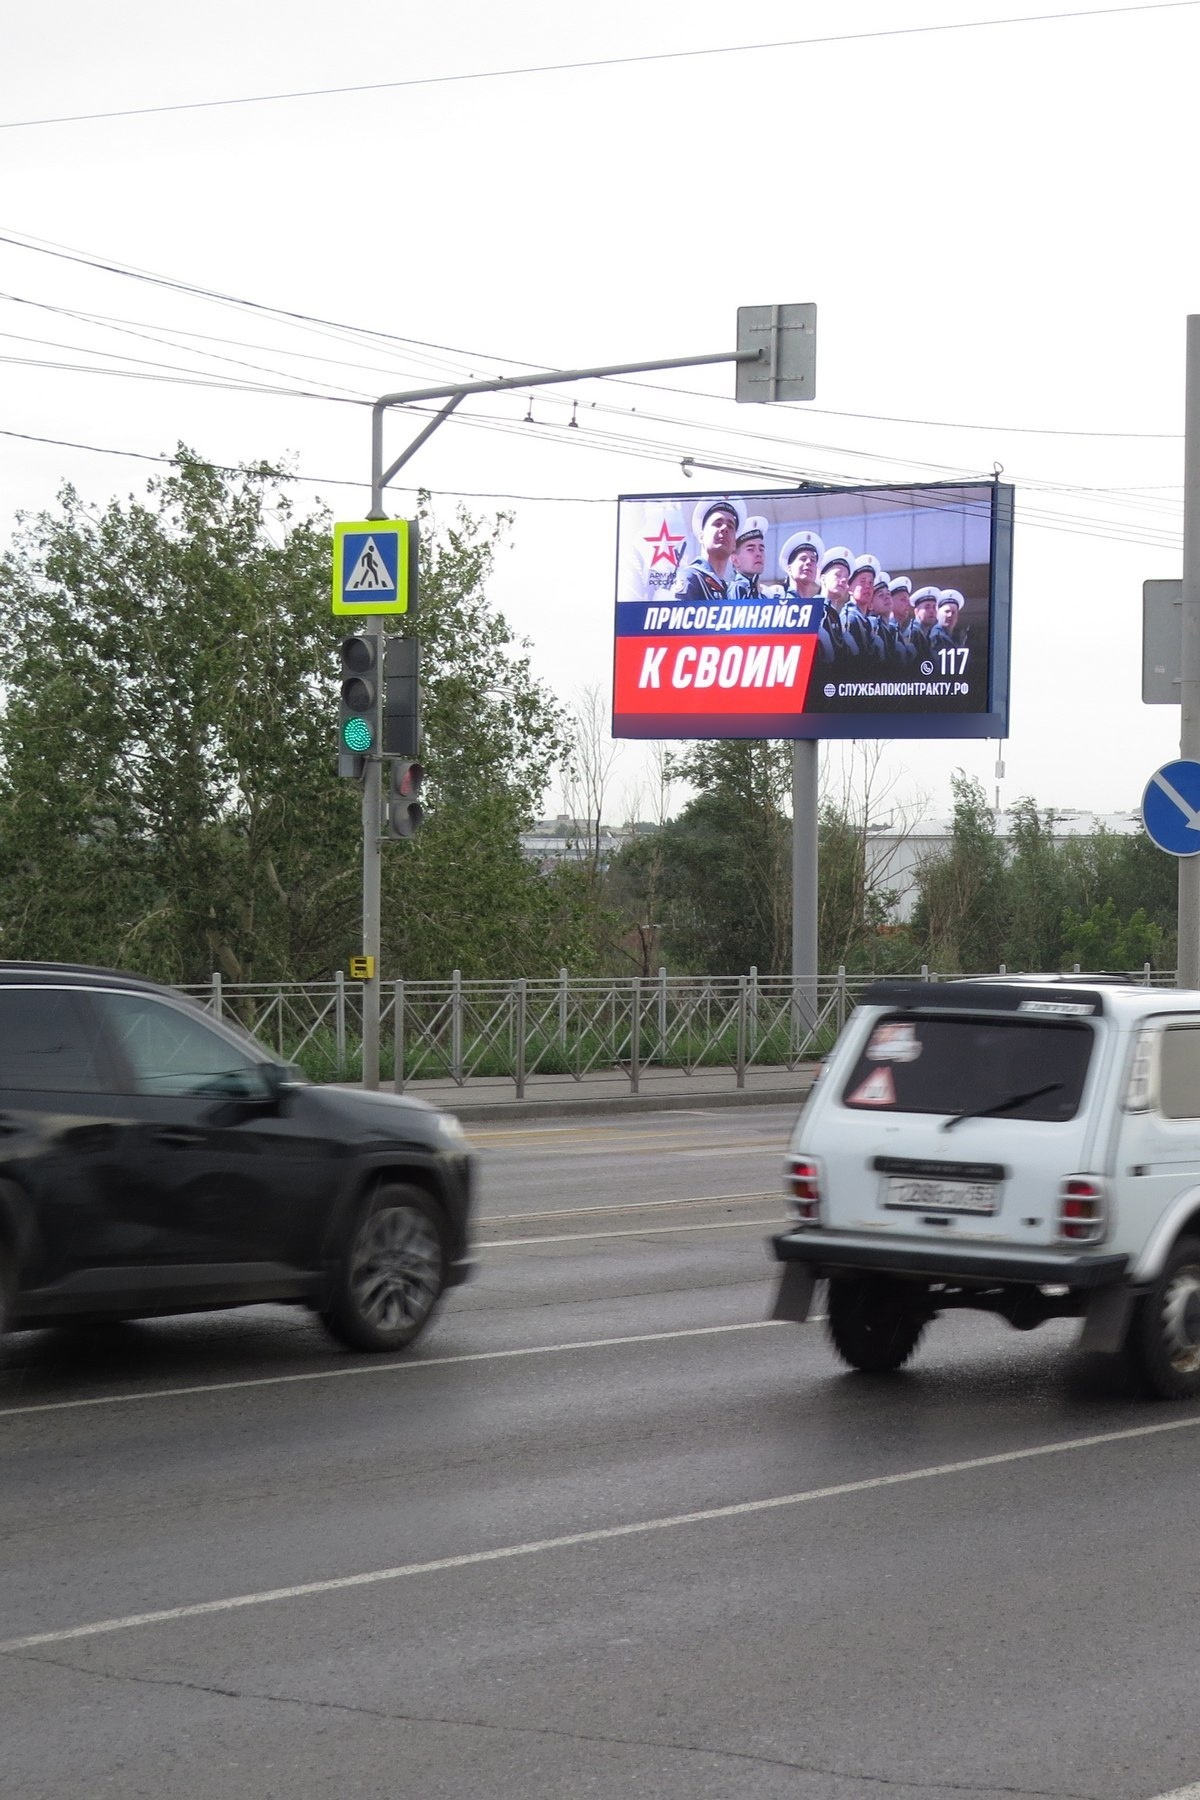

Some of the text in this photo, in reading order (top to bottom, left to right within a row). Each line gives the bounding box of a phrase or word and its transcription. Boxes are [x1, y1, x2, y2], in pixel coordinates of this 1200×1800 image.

[643, 600, 813, 631] ПРИСОЕДИНЯЙСЯ
[638, 645, 802, 689] К СВОИМ
[937, 647, 970, 675] 117
[838, 682, 969, 697] СЛУЖБАПОКОНТРАКТУ.РФ
